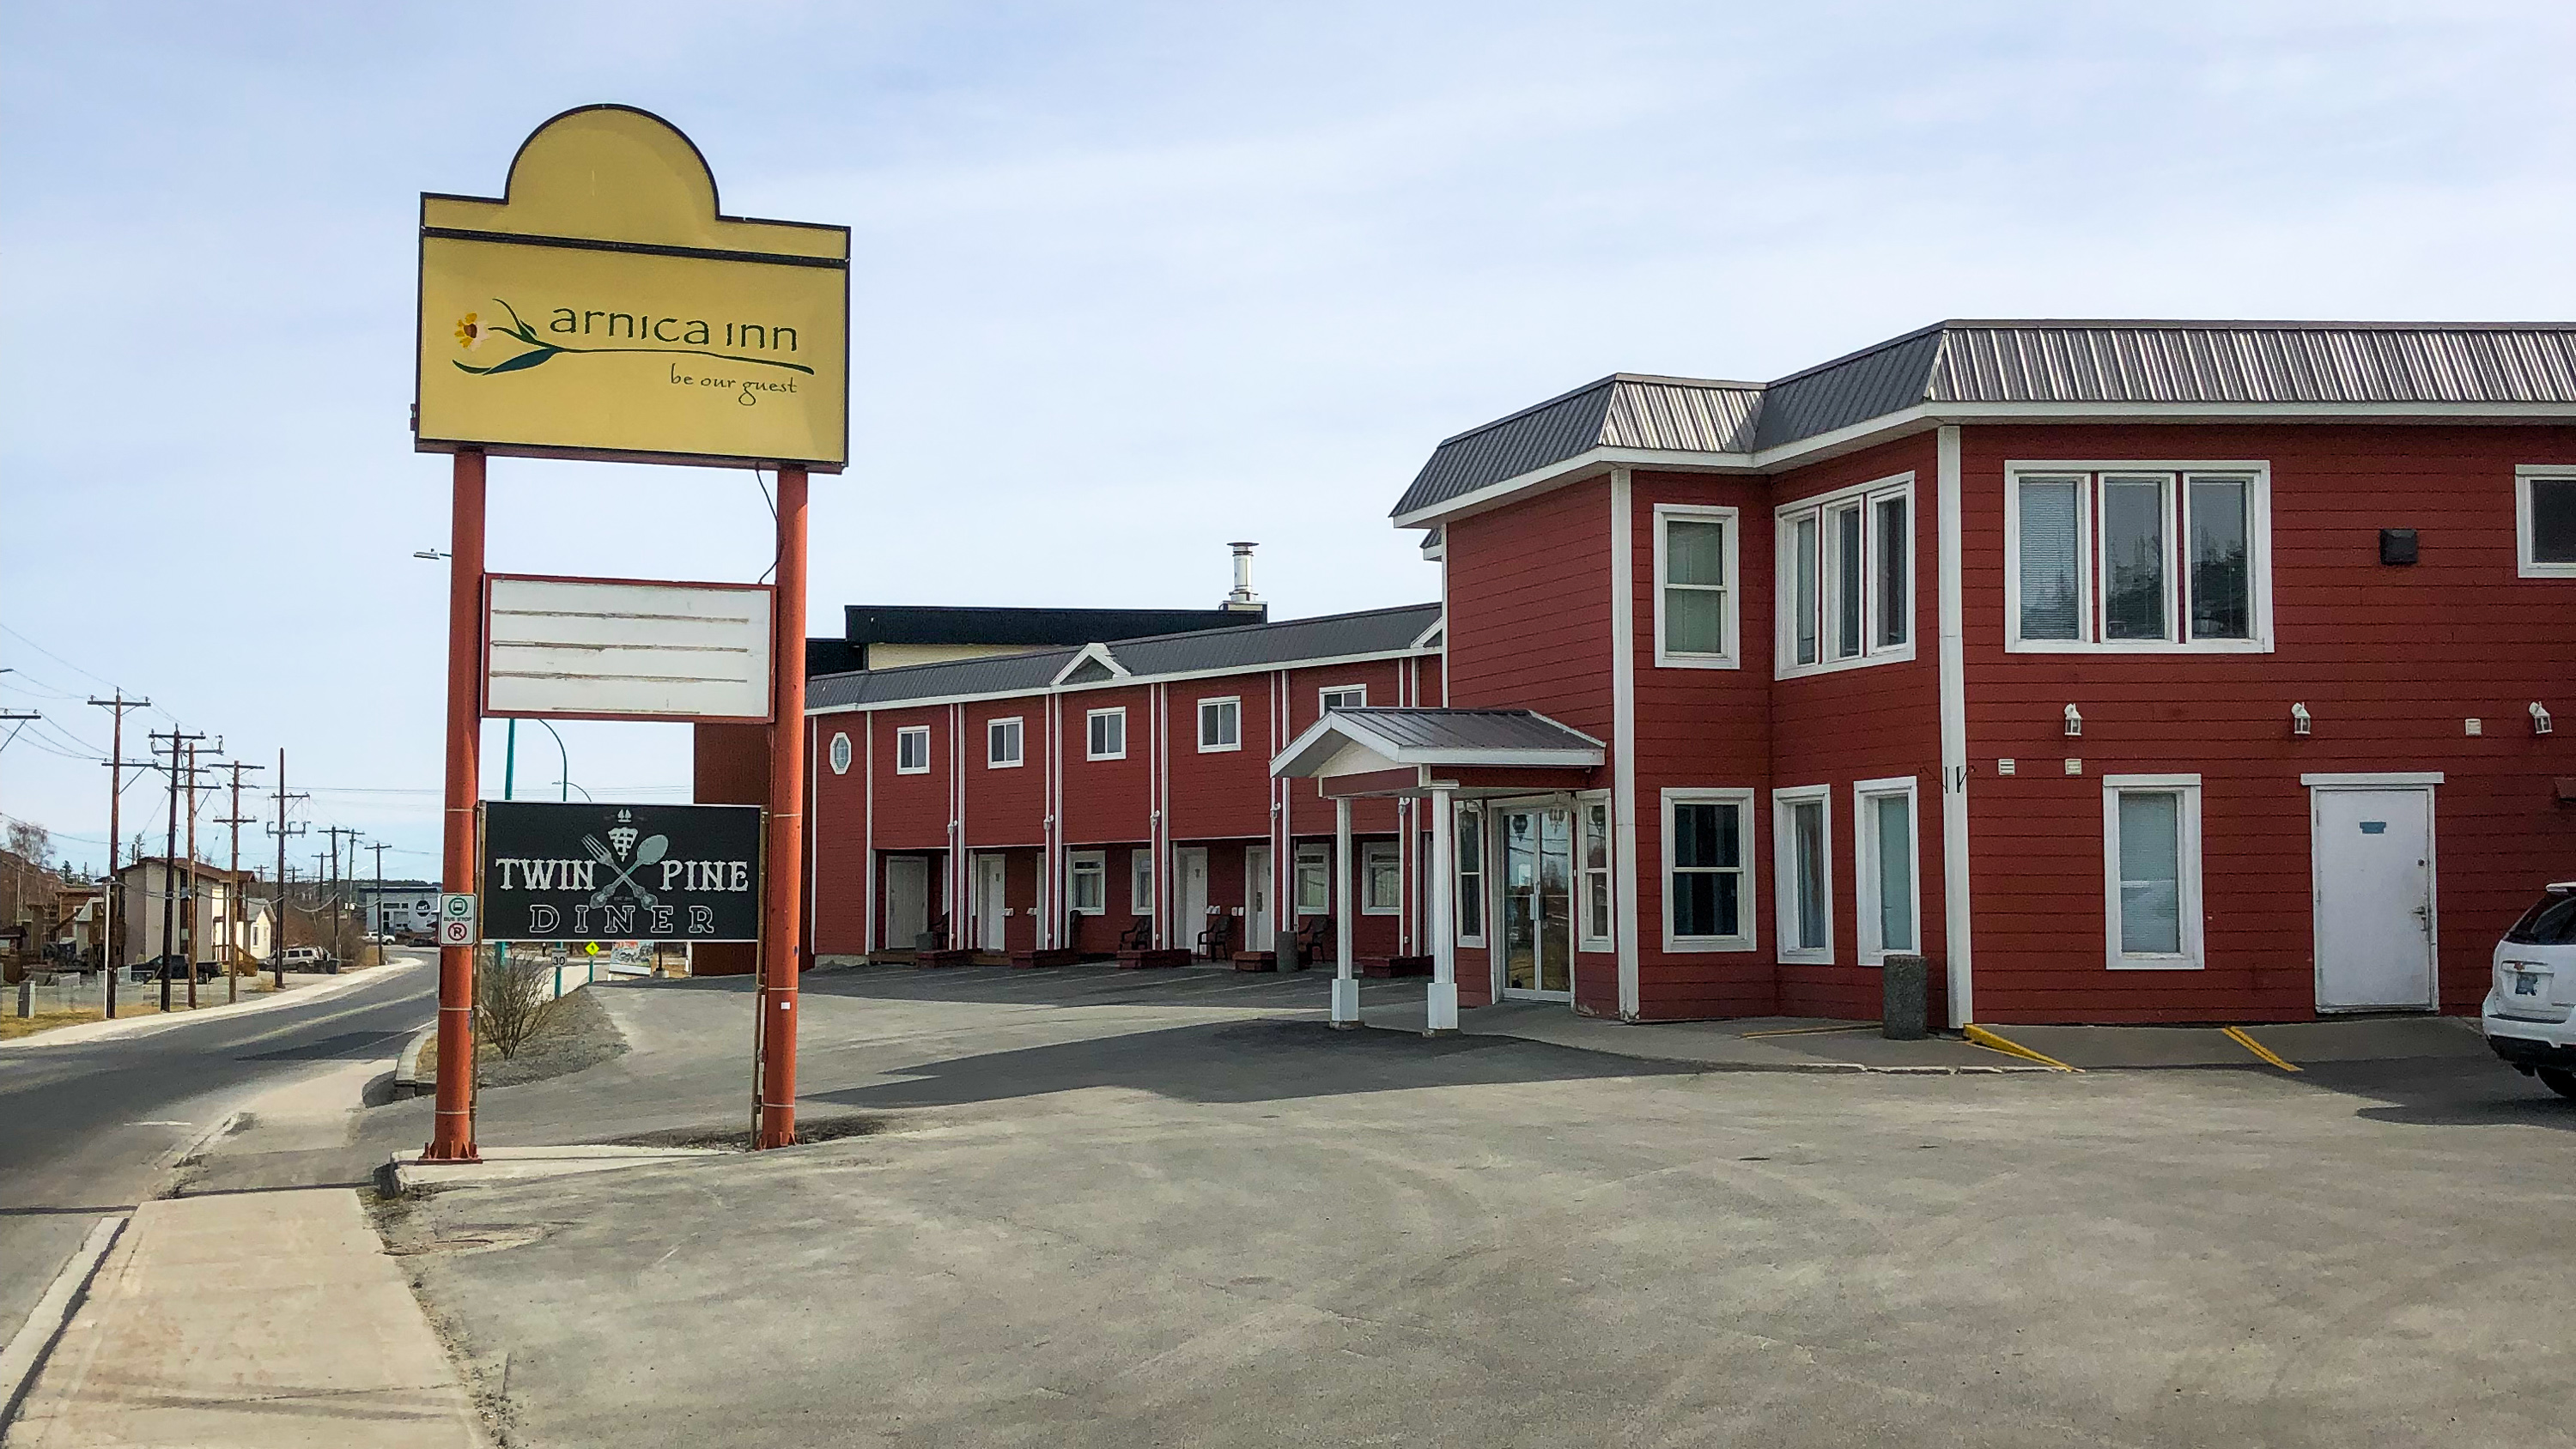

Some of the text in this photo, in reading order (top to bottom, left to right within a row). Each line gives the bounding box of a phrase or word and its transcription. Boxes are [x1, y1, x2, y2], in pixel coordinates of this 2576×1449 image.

[550, 307, 798, 352] arnica inn
[671, 362, 798, 406] be our guest
[495, 858, 749, 893] TWIN PINE
[529, 904, 715, 934] DINER
[552, 955, 566, 967] 30
